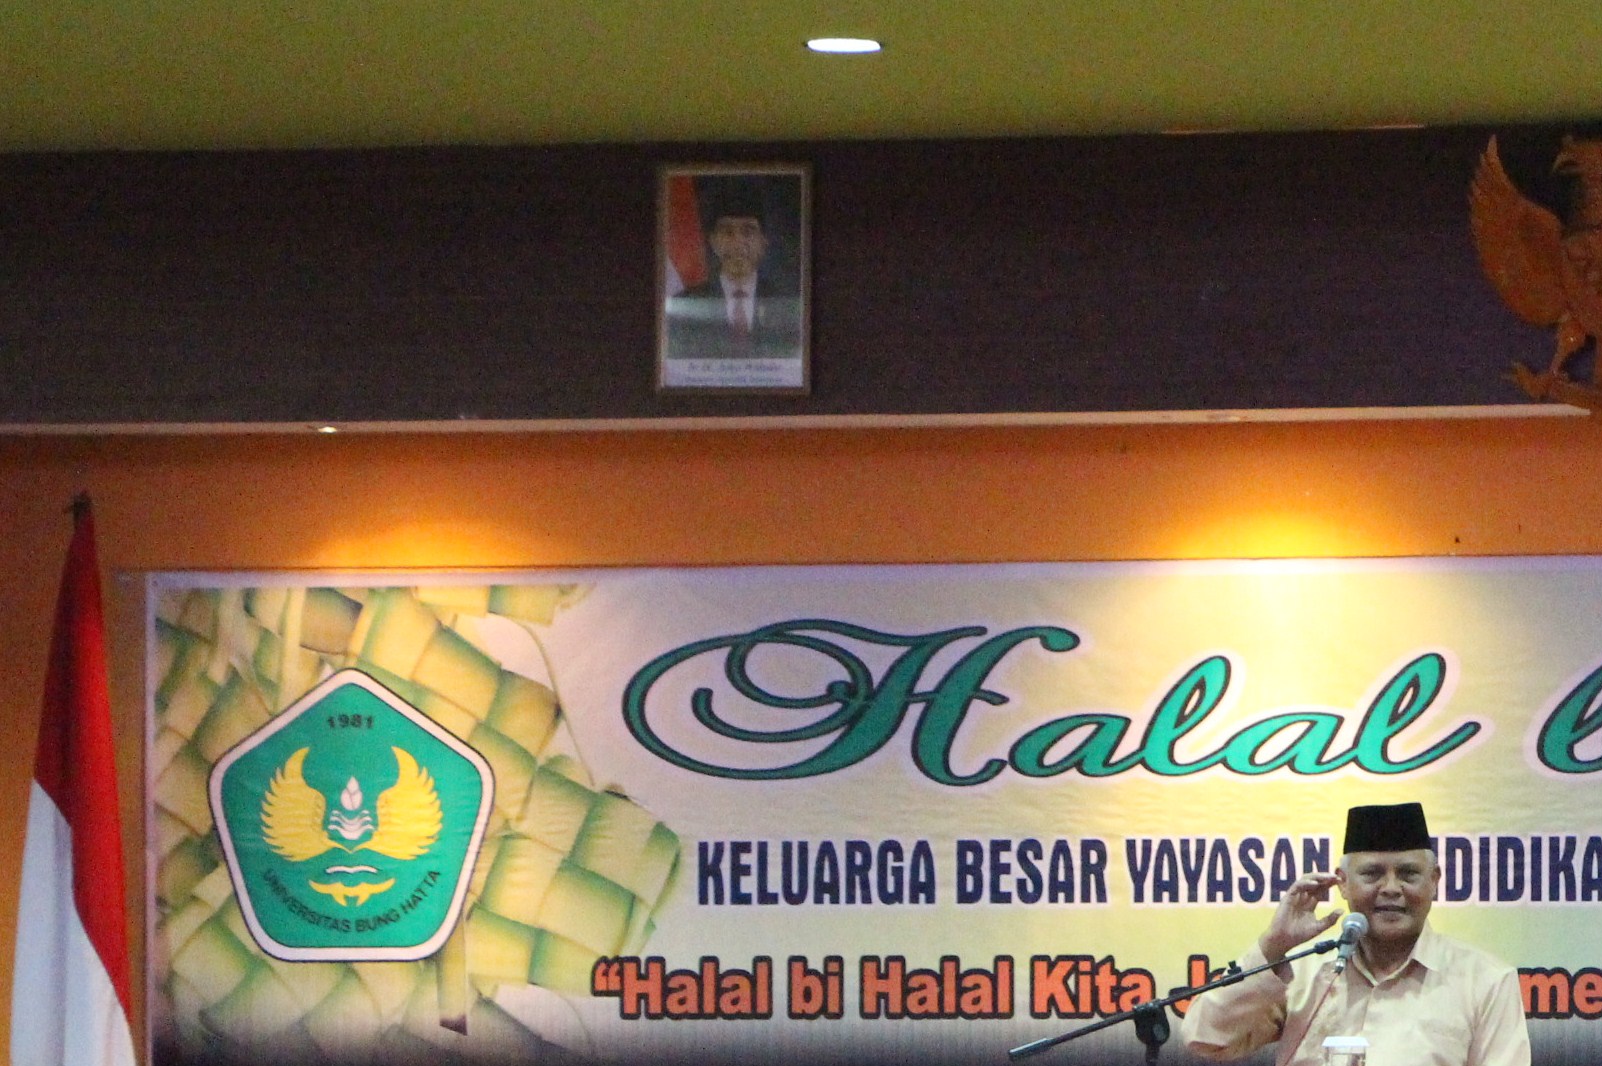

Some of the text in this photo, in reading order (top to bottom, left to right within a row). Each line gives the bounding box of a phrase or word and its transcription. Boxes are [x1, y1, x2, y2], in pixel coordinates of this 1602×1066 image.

[328, 713, 373, 729] 1981
[622, 618, 1481, 786] Halal
[698, 839, 936, 905] KELUARGA
[955, 839, 1107, 904] BESAR
[1125, 837, 1330, 903] YAYASAN
[591, 955, 772, 1020] “Halal
[787, 955, 843, 1020] bi
[860, 955, 1013, 1020] Halal
[1030, 955, 1156, 1019] Kita
